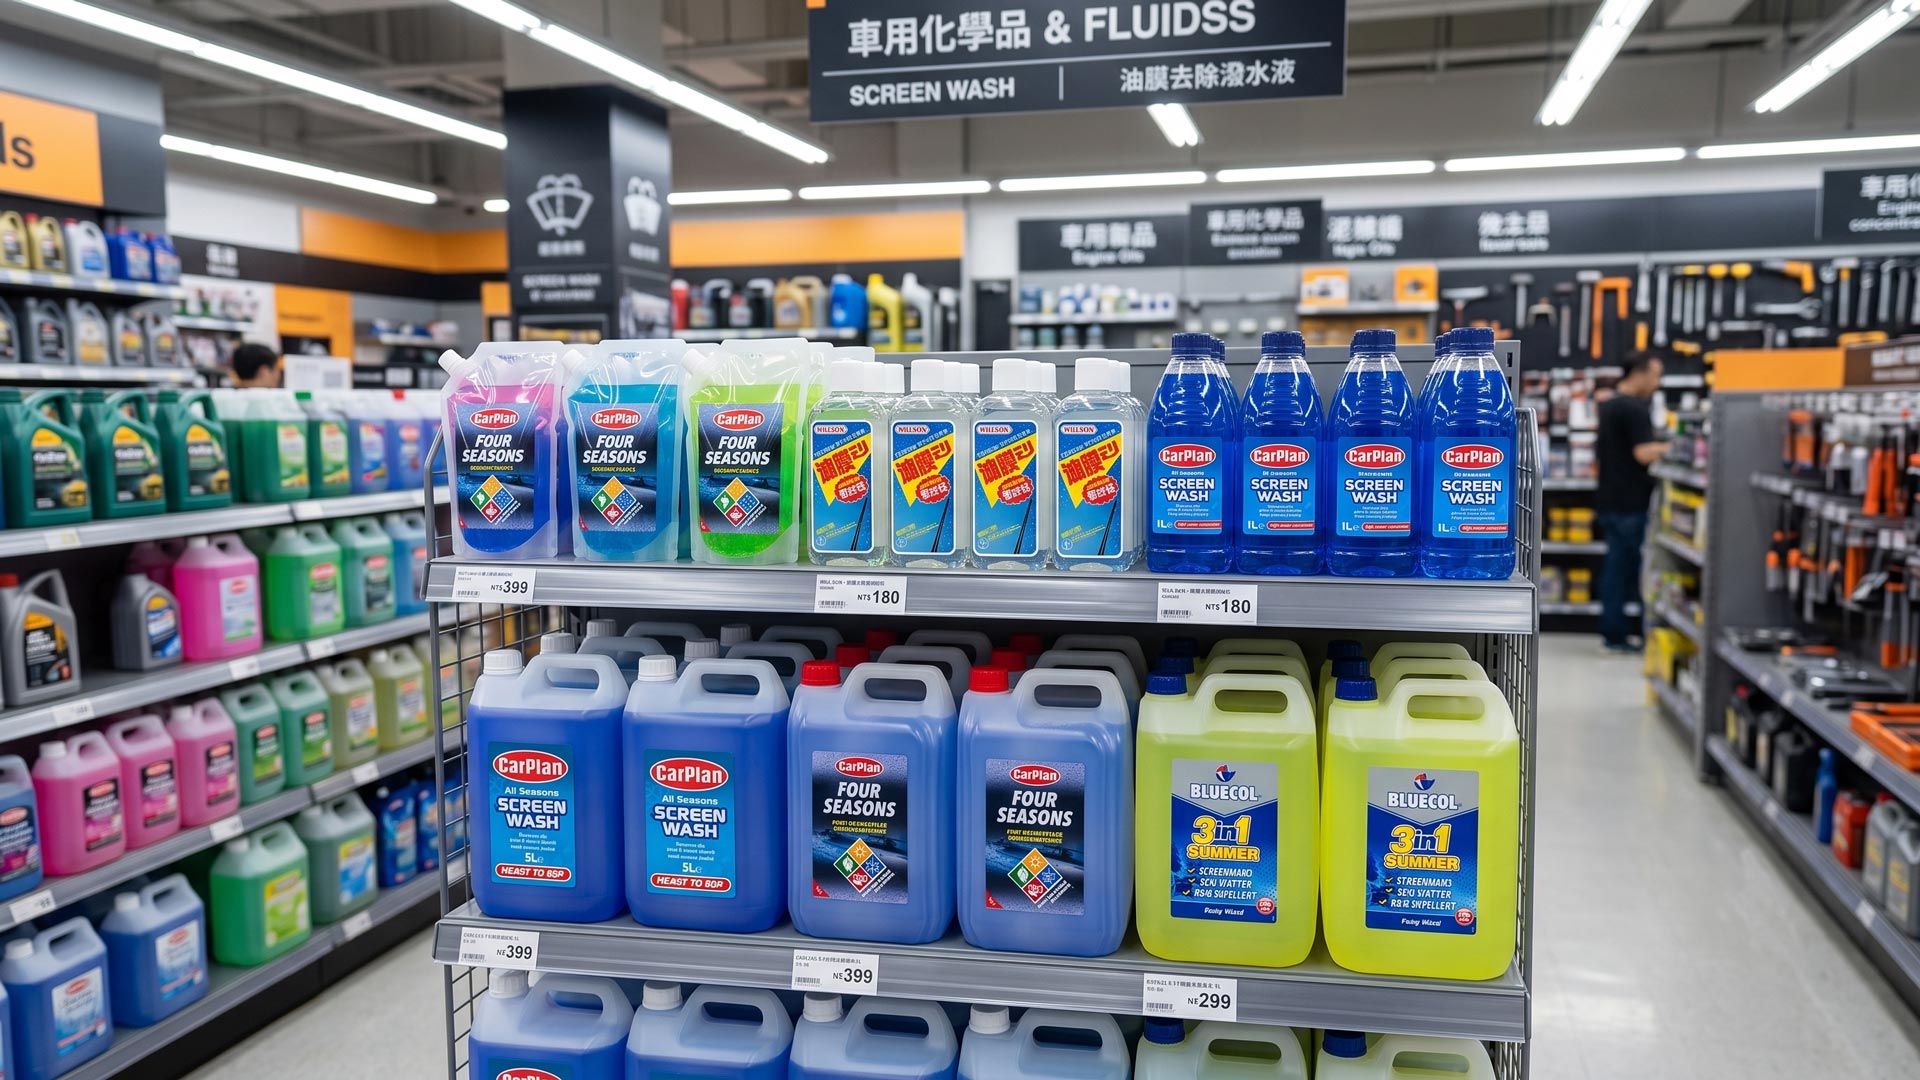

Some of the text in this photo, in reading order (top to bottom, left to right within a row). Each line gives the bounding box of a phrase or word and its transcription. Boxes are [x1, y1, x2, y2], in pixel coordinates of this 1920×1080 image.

[848, 0, 1257, 58] 車用化學品 & FLUIDSS
[1119, 58, 1297, 94] 油膜去除潑水液
[849, 77, 1015, 107] SCREEN WASH
[474, 413, 516, 424] CarPlan
[595, 413, 639, 424] CarPlan
[717, 414, 762, 425] CarPlan
[475, 434, 512, 448] FOUR
[596, 435, 634, 448] FOUR
[718, 436, 757, 449] FOUR
[462, 449, 524, 463] SEASONS
[583, 450, 647, 464] SEASONS
[705, 451, 771, 465] SEASONS
[1162, 449, 1213, 462] CarPlan
[1254, 449, 1306, 463] CarPlan
[1349, 449, 1402, 463] CarPlan
[1446, 450, 1500, 464] CarPlan
[1159, 478, 1215, 489] SCREEN
[1251, 478, 1309, 490] SCREEN
[1345, 479, 1404, 491] SCREEN
[1442, 480, 1502, 492] SCREEN
[1165, 490, 1209, 502] WASH
[1257, 491, 1303, 502] WASH
[1352, 492, 1398, 503] WASH
[1449, 493, 1496, 504] WASH
[503, 580, 529, 594] 399
[872, 590, 900, 604] 180
[1221, 599, 1251, 614] 180
[498, 757, 563, 775] CarPlan
[838, 760, 881, 773] CarPlan
[656, 765, 723, 784] CarPlan
[1012, 769, 1058, 781] CarPlan
[505, 787, 559, 797] All Seasons
[837, 781, 882, 798] FOUR
[1190, 783, 1259, 801] BLUECOL
[662, 795, 718, 805] All Seasons
[1011, 790, 1058, 807] FOUR
[1387, 792, 1459, 810] BLUECOL
[497, 797, 567, 815] SCREEN
[823, 799, 896, 817] SEASONS
[505, 813, 559, 829] WASH
[654, 805, 726, 823] SCREEN
[997, 807, 1074, 827] SEASONS
[662, 822, 718, 838] WASH
[1192, 815, 1252, 845] 3in1
[1389, 824, 1452, 855] 3in1
[1187, 845, 1260, 861] SUMMER
[1384, 854, 1460, 871] SUMMER
[501, 866, 530, 876] HEAST
[533, 868, 545, 877] TO
[657, 876, 688, 886] HEAST
[690, 878, 702, 887] TO
[506, 945, 533, 960] 399
[843, 968, 873, 984] 399
[1199, 992, 1231, 1009] 299
